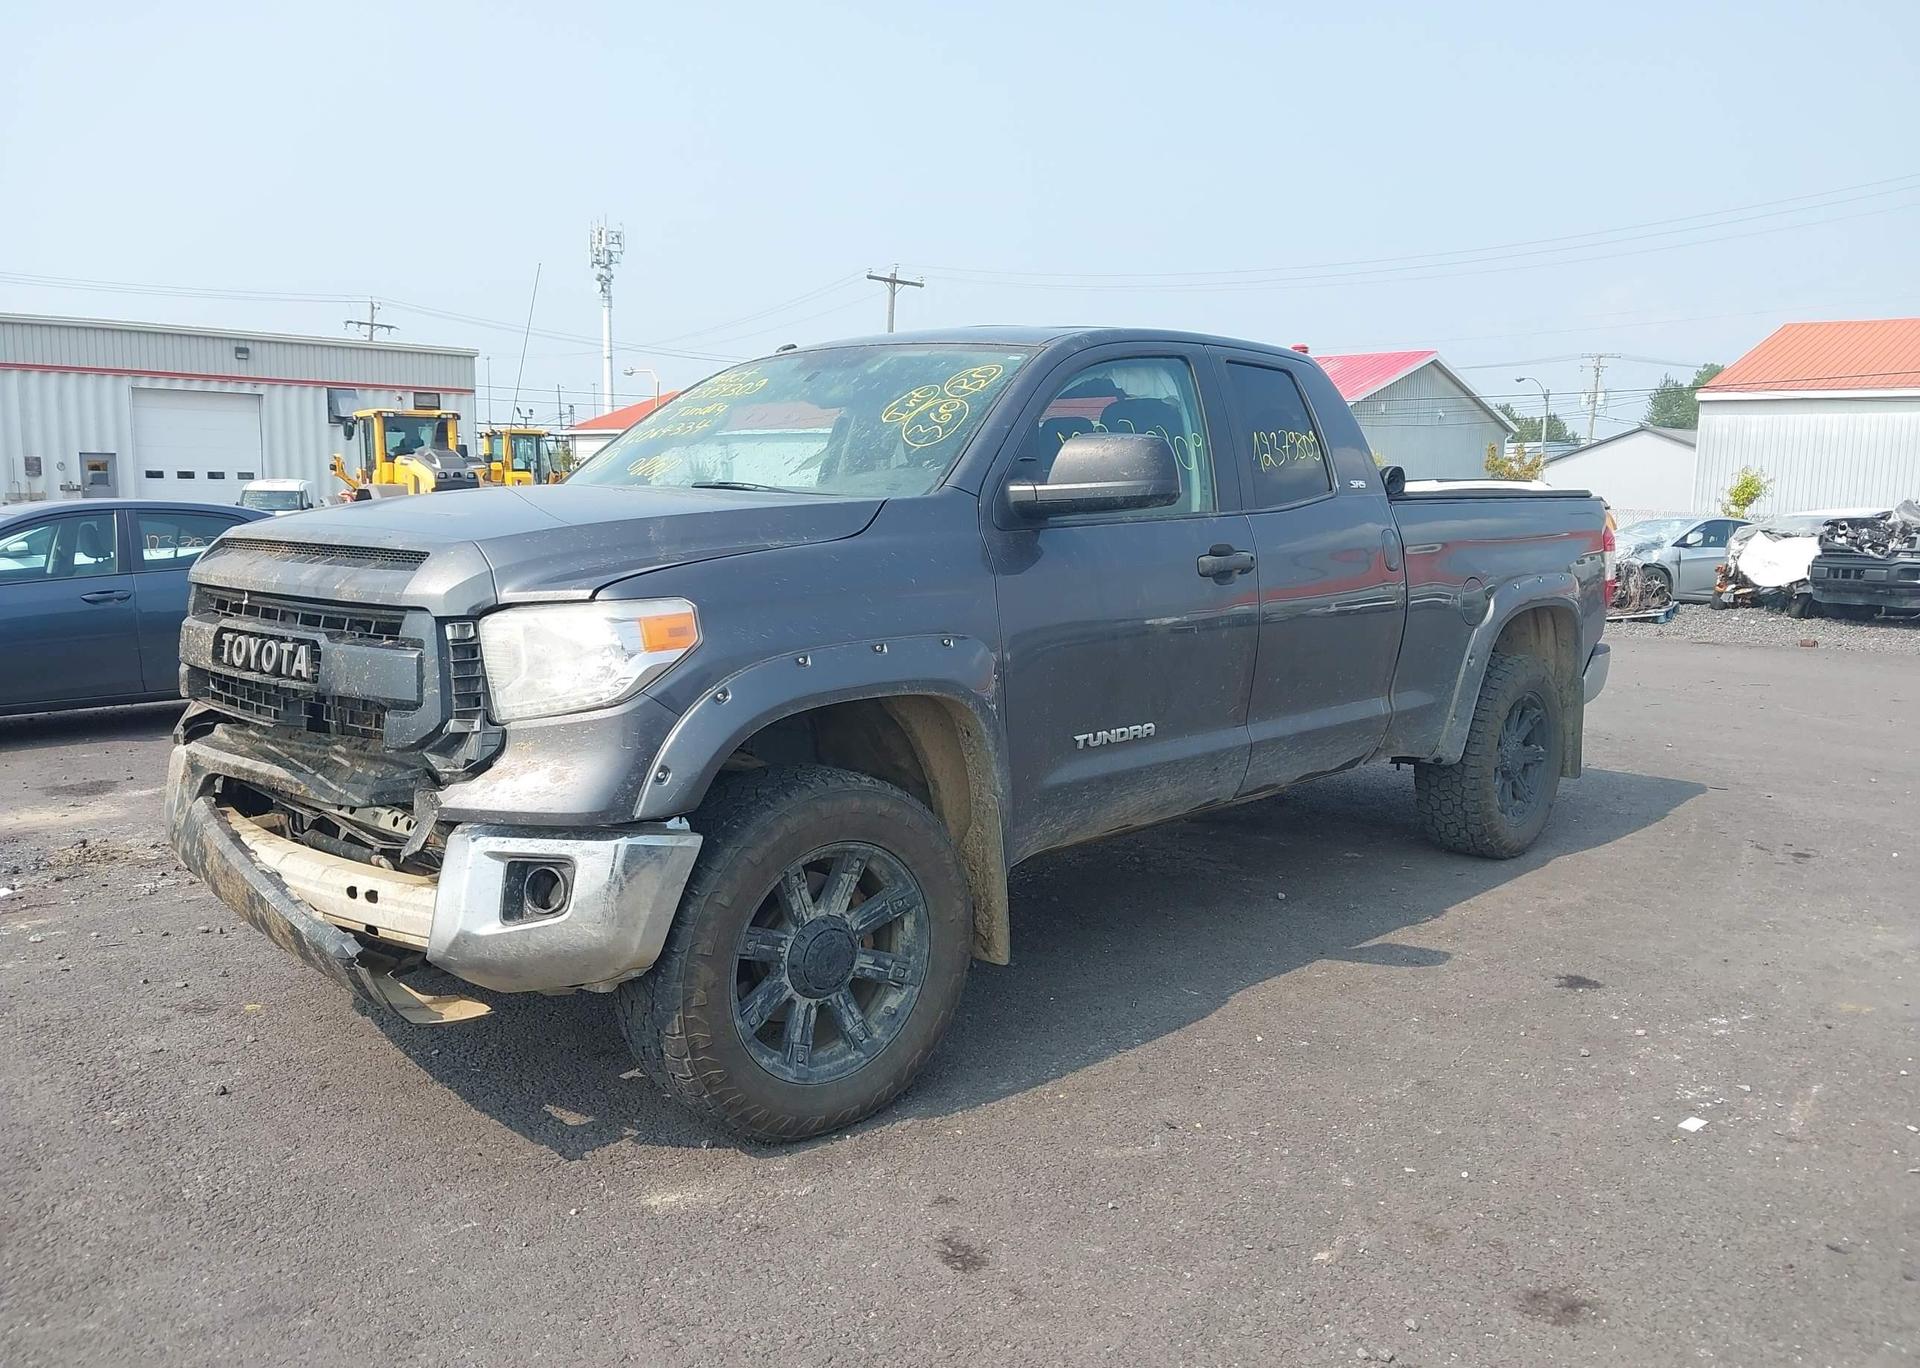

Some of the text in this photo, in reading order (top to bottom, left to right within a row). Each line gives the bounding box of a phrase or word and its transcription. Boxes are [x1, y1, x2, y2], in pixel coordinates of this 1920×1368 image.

[906, 401, 961, 439] 360
[221, 632, 313, 680] TOYOTA
[1073, 722, 1156, 750] TUNDRA
